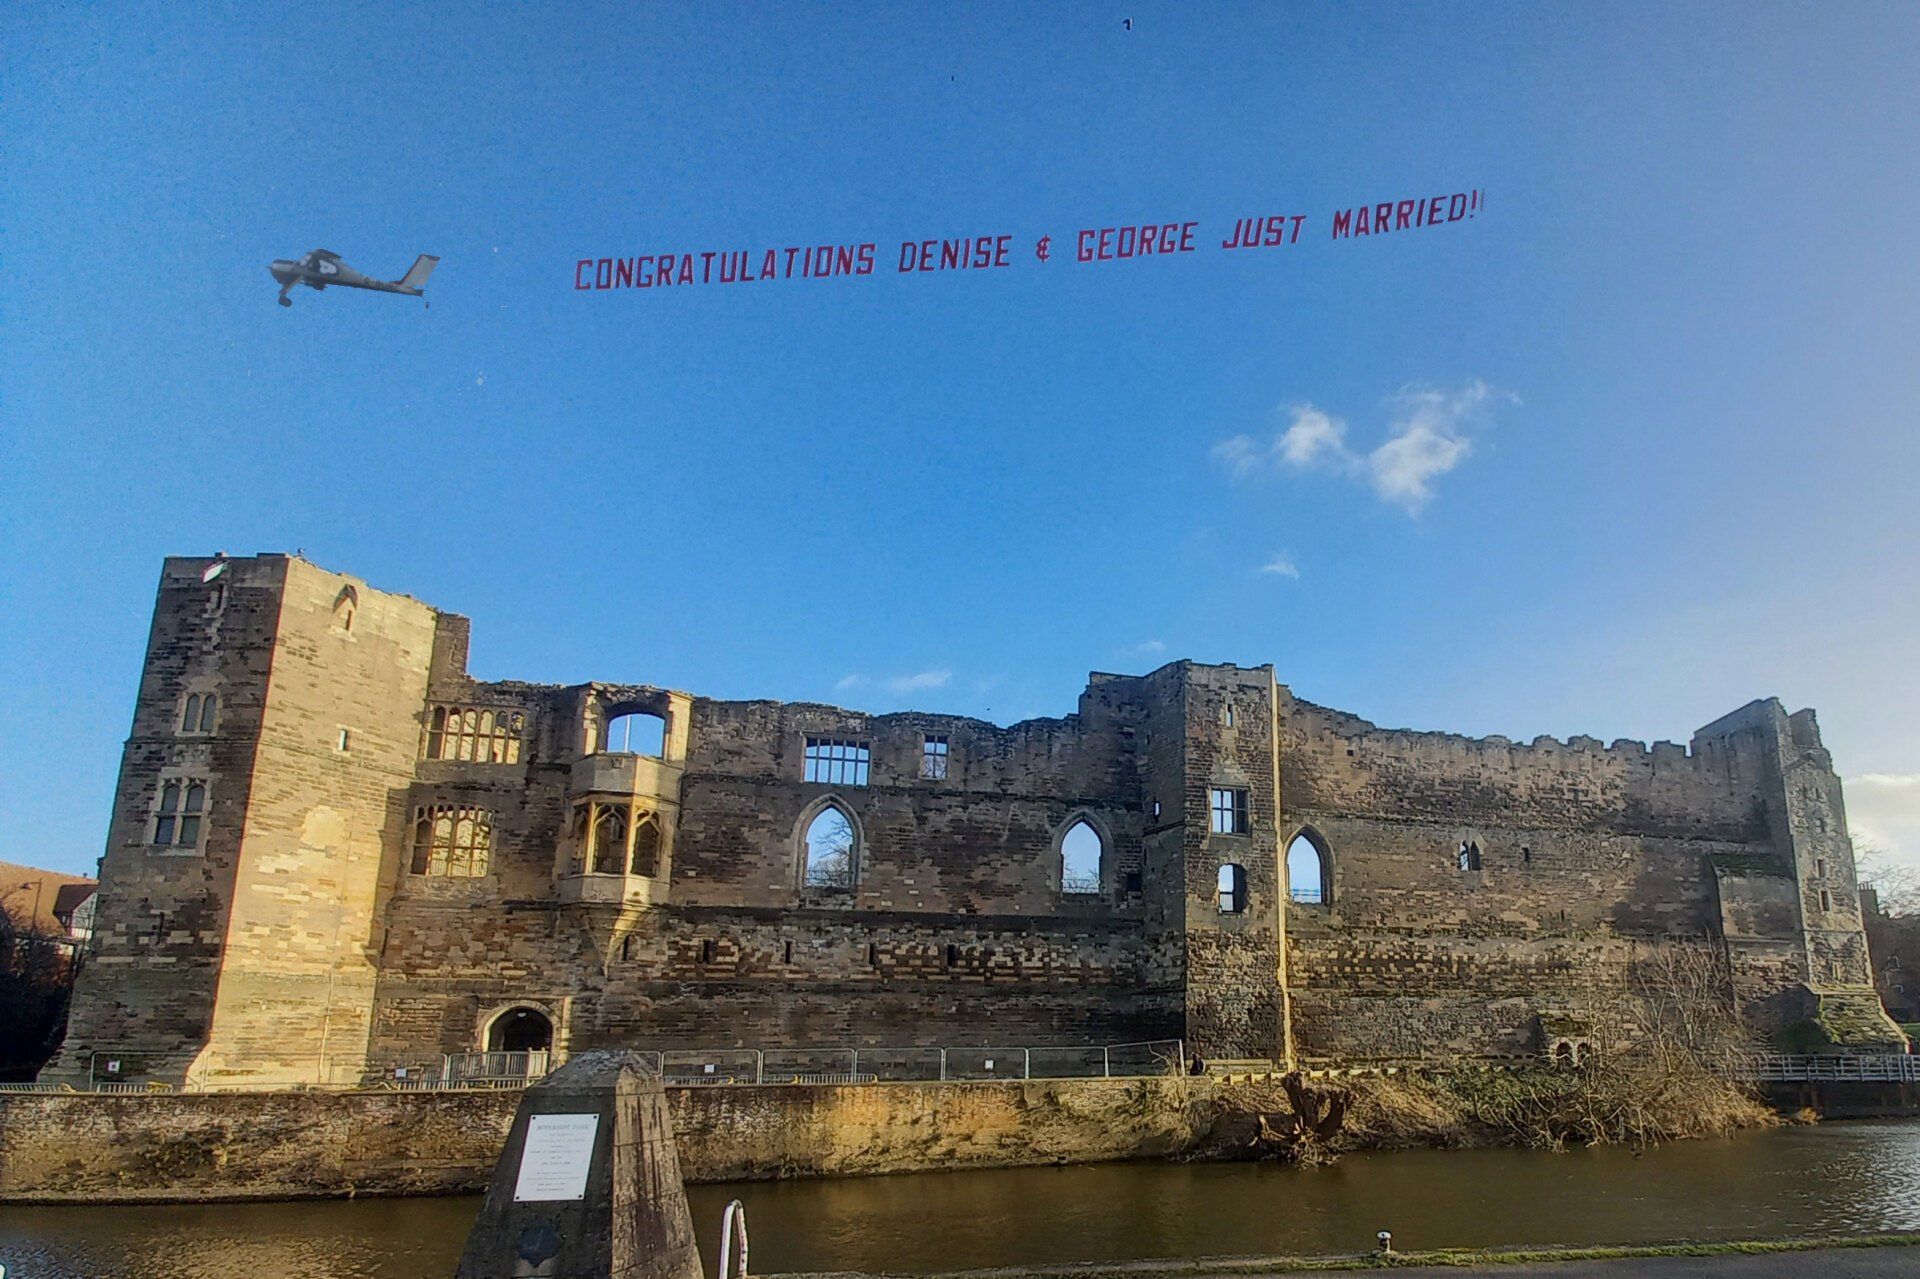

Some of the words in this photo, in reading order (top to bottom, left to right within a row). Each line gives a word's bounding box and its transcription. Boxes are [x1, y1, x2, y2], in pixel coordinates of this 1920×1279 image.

[574, 243, 877, 291] CONGRATULATIONS
[899, 236, 1013, 273] DENISE
[1076, 221, 1198, 263] GEORGE
[1221, 215, 1307, 250] JUST
